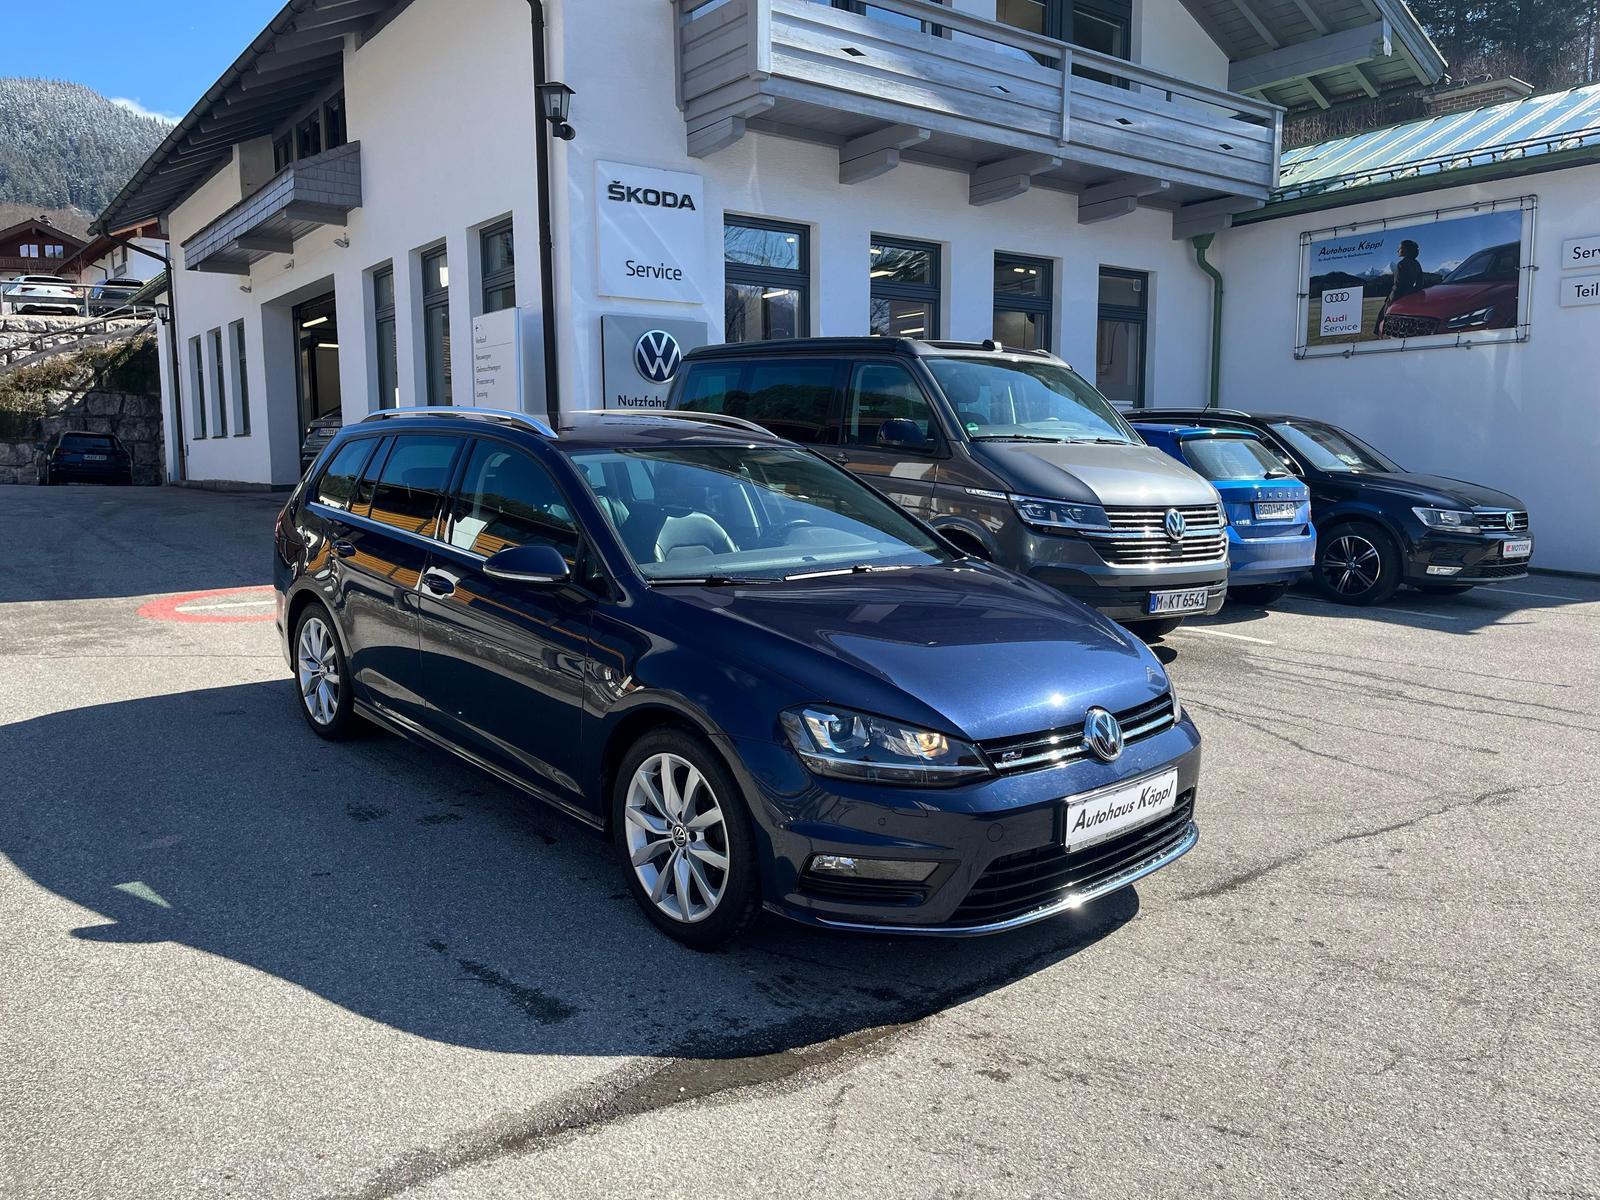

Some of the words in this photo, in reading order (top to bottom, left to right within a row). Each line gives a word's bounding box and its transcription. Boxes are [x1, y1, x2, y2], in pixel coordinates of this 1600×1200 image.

[607, 180, 696, 211] ŠKODA
[1318, 246, 1356, 257] Autohaus
[1357, 239, 1385, 251] Köppl
[1572, 246, 1600, 260] Ser
[625, 260, 683, 280] Service
[1574, 282, 1599, 298] Teil
[1324, 314, 1348, 323] Audi
[1323, 324, 1358, 333] Service
[617, 395, 667, 408] Nutzfahr
[1156, 595, 1164, 610] M
[1168, 594, 1182, 609] KT
[1183, 592, 1205, 607] 6541
[1072, 802, 1135, 833] Autohaus
[1137, 779, 1174, 810] Köppl
